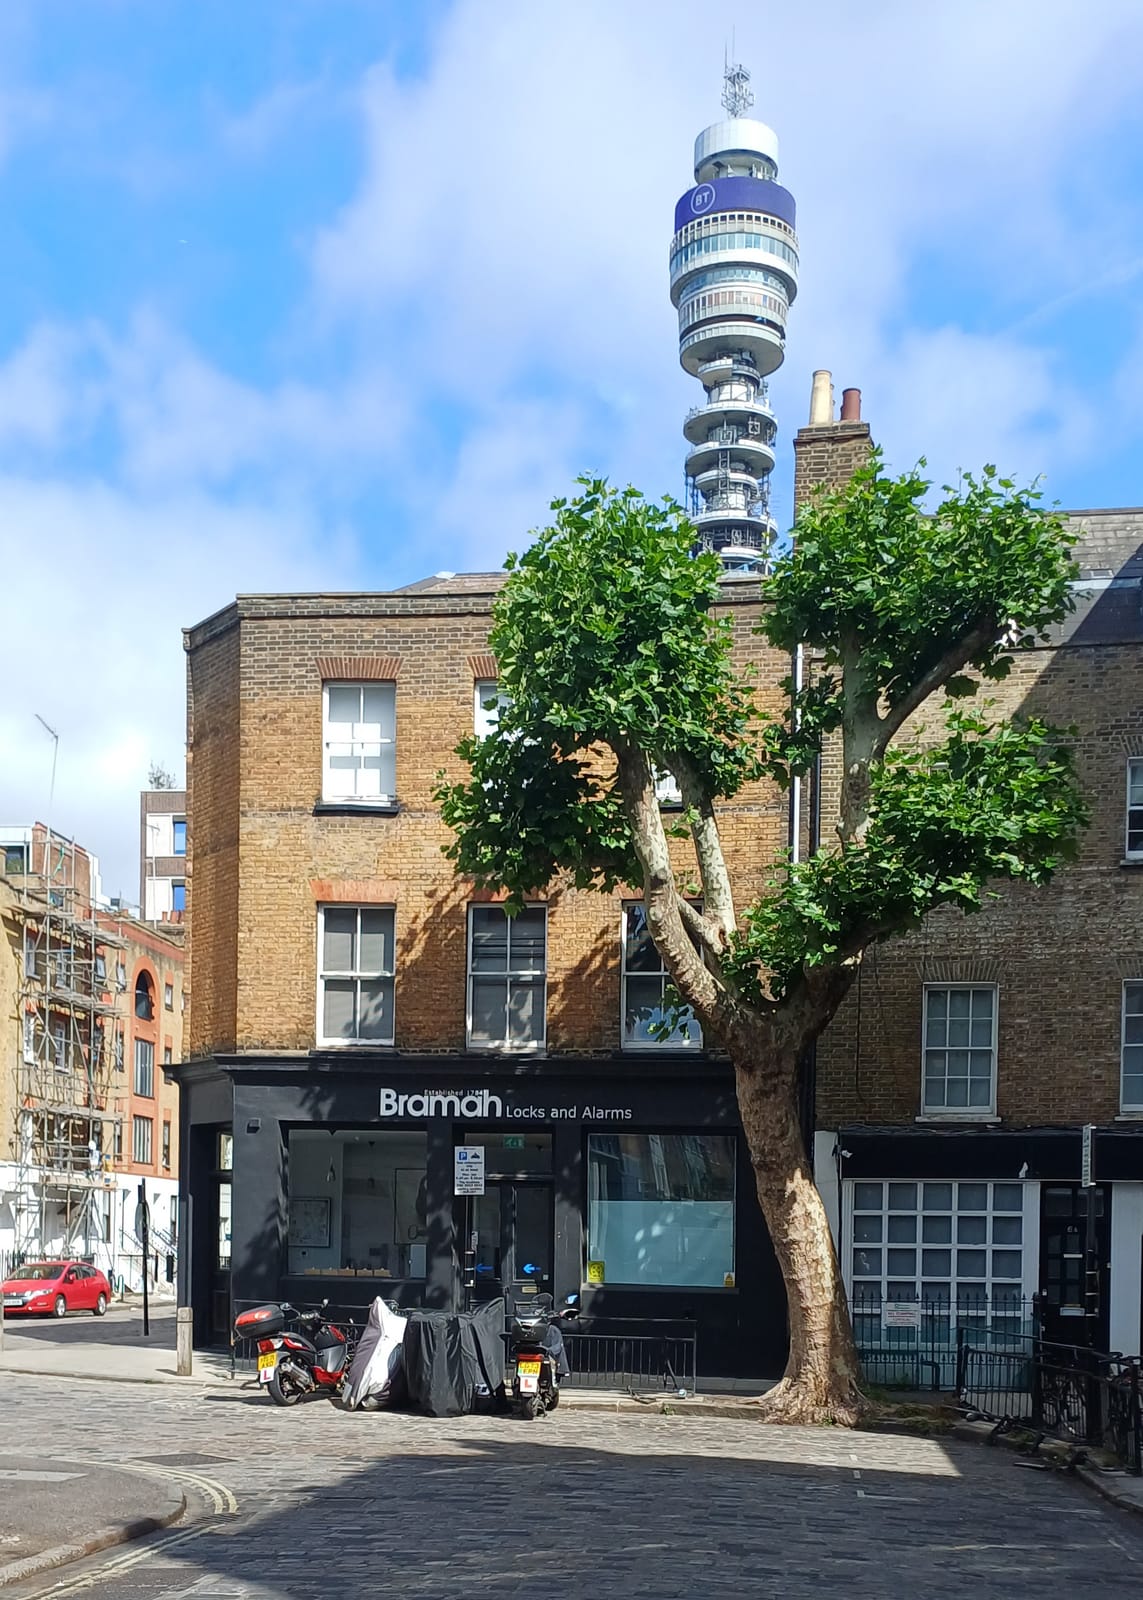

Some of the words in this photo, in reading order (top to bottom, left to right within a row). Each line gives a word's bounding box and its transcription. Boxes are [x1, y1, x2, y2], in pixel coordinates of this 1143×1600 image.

[695, 191, 710, 206] BT
[380, 1088, 502, 1117] Bramah
[506, 1105, 546, 1119] Locks
[550, 1105, 577, 1119] and
[581, 1105, 633, 1120] Alarms
[263, 1369, 272, 1380] L
[524, 1379, 532, 1388] L
